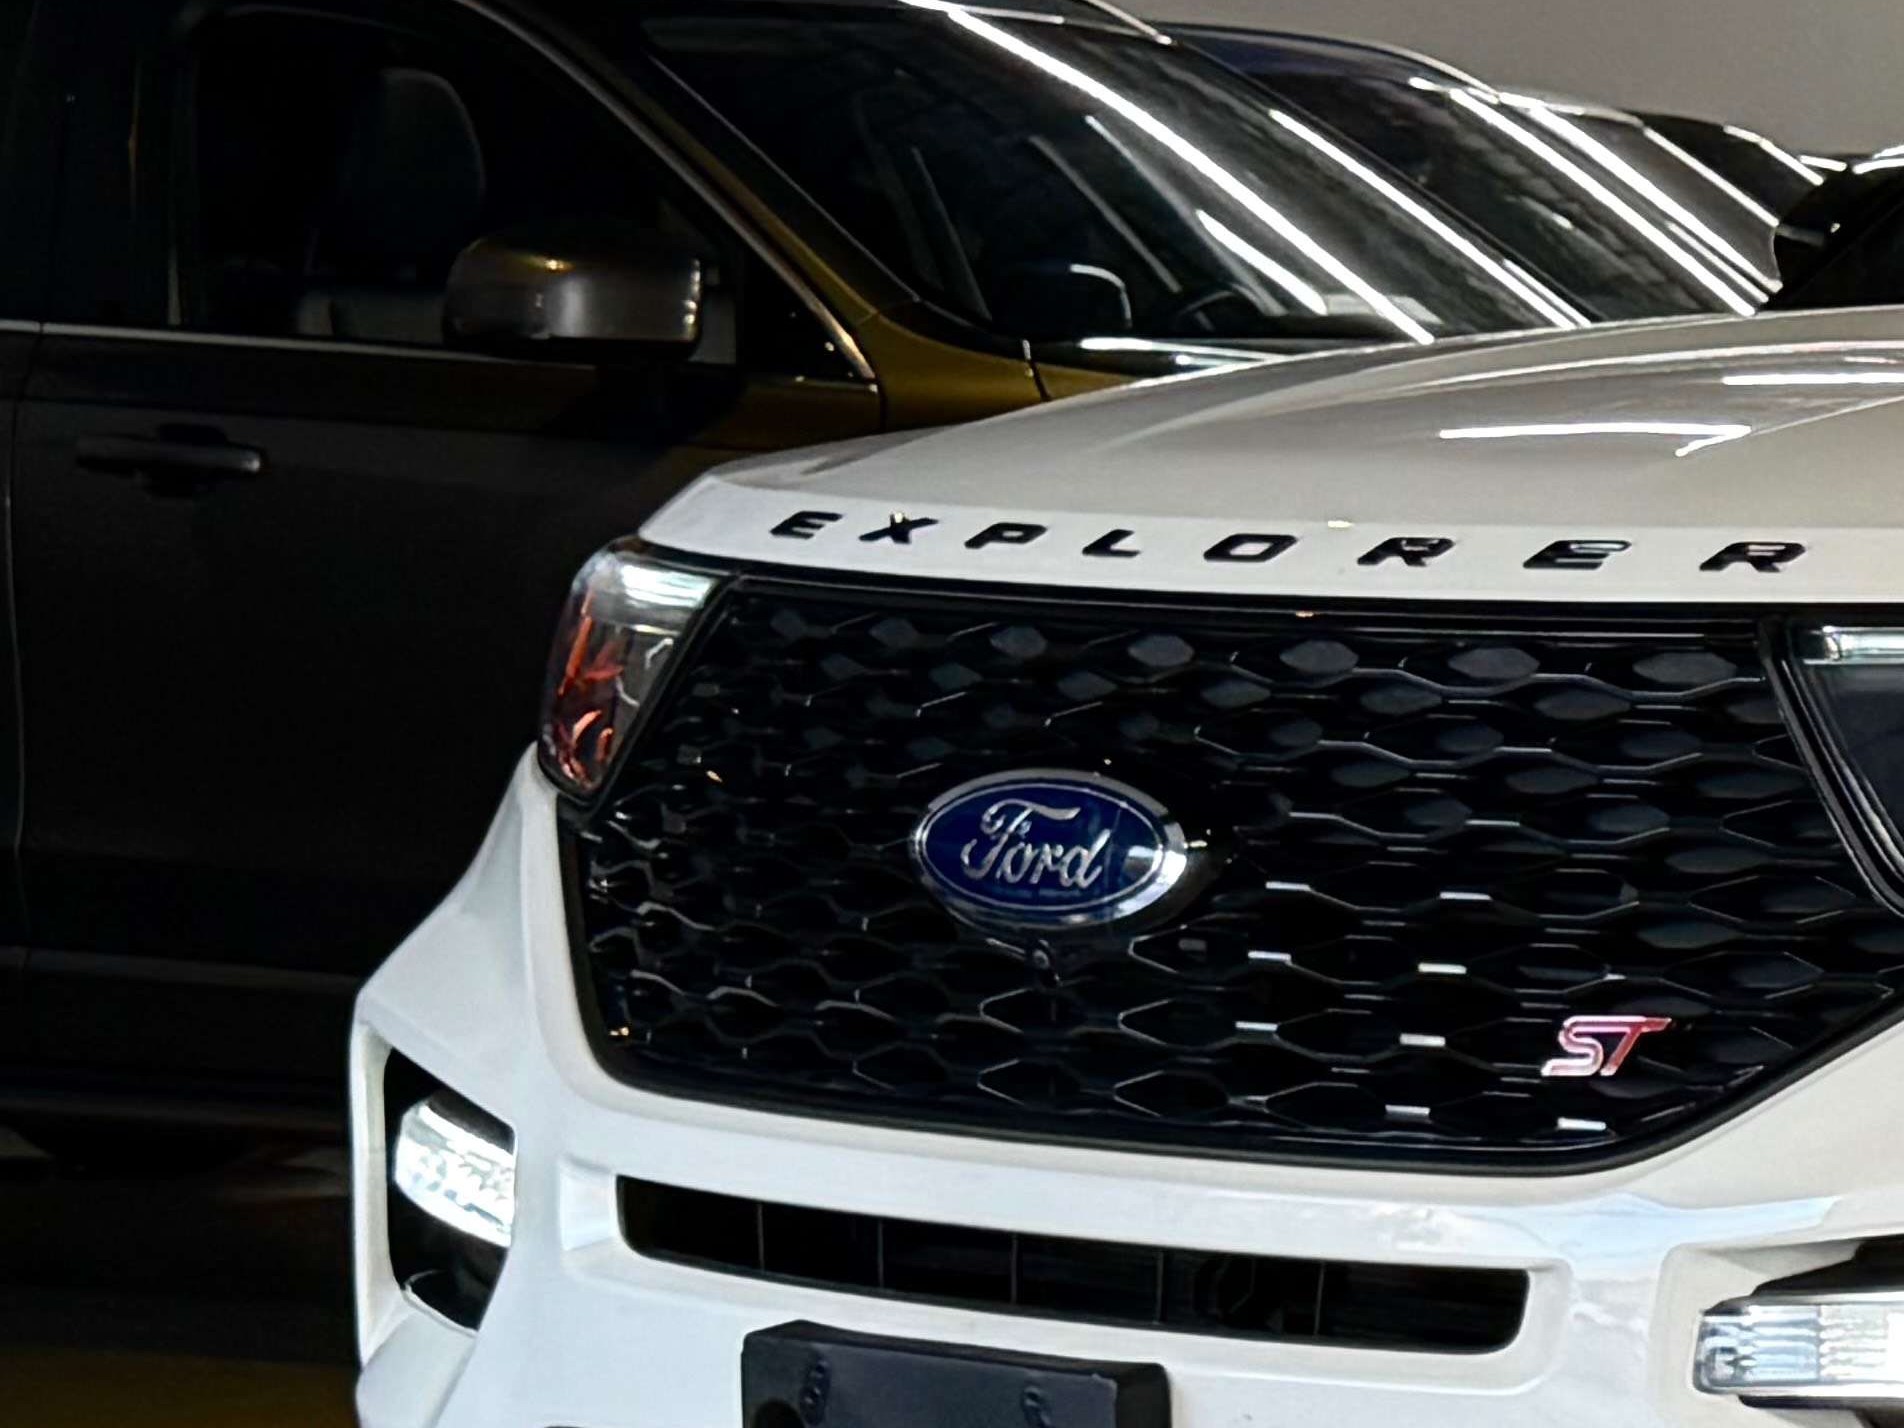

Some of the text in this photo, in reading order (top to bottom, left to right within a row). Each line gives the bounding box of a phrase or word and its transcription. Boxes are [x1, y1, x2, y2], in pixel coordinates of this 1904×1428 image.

[769, 510, 1808, 573] EXPLORER
[960, 798, 1112, 889] Ford
[1541, 1015, 1672, 1077] ST
